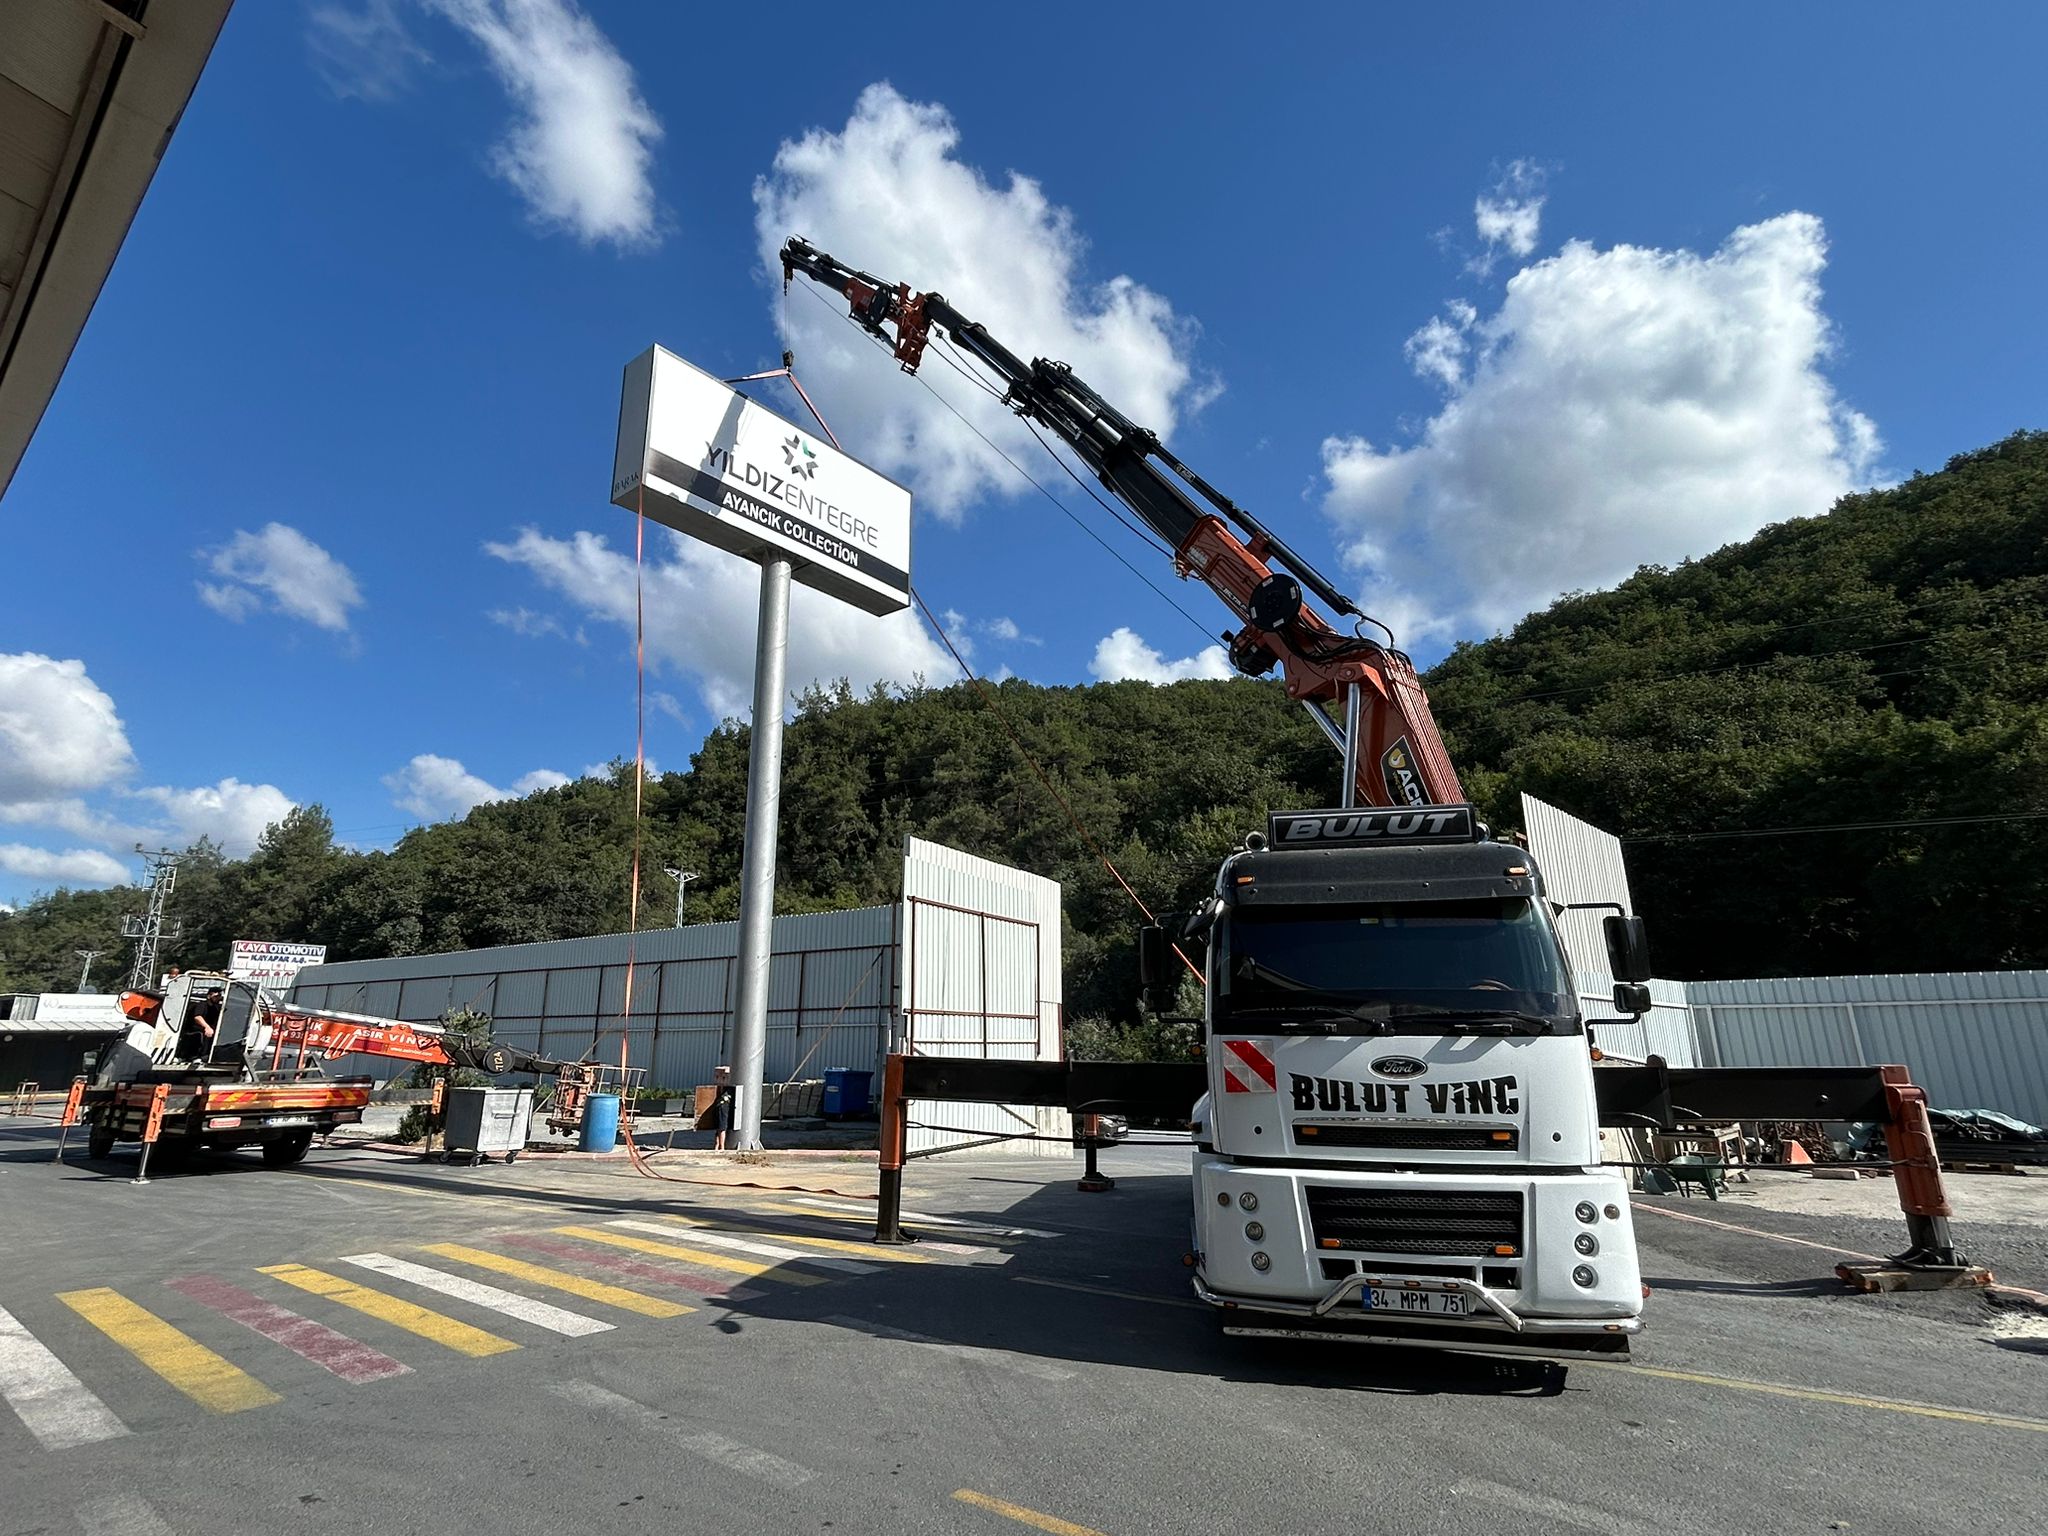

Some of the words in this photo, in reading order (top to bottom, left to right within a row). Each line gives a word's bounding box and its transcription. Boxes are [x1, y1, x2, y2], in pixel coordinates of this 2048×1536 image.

[723, 491, 782, 531] AYANCIK
[1284, 812, 1458, 841] BULUT
[237, 942, 267, 953] KAYA
[250, 954, 289, 962] KAYAPAR
[1383, 1060, 1414, 1075] Ford
[1288, 1072, 1411, 1114] BULUT
[1371, 1289, 1390, 1308] 34
[1400, 1291, 1431, 1311] MPM
[1441, 1294, 1467, 1314] 751
